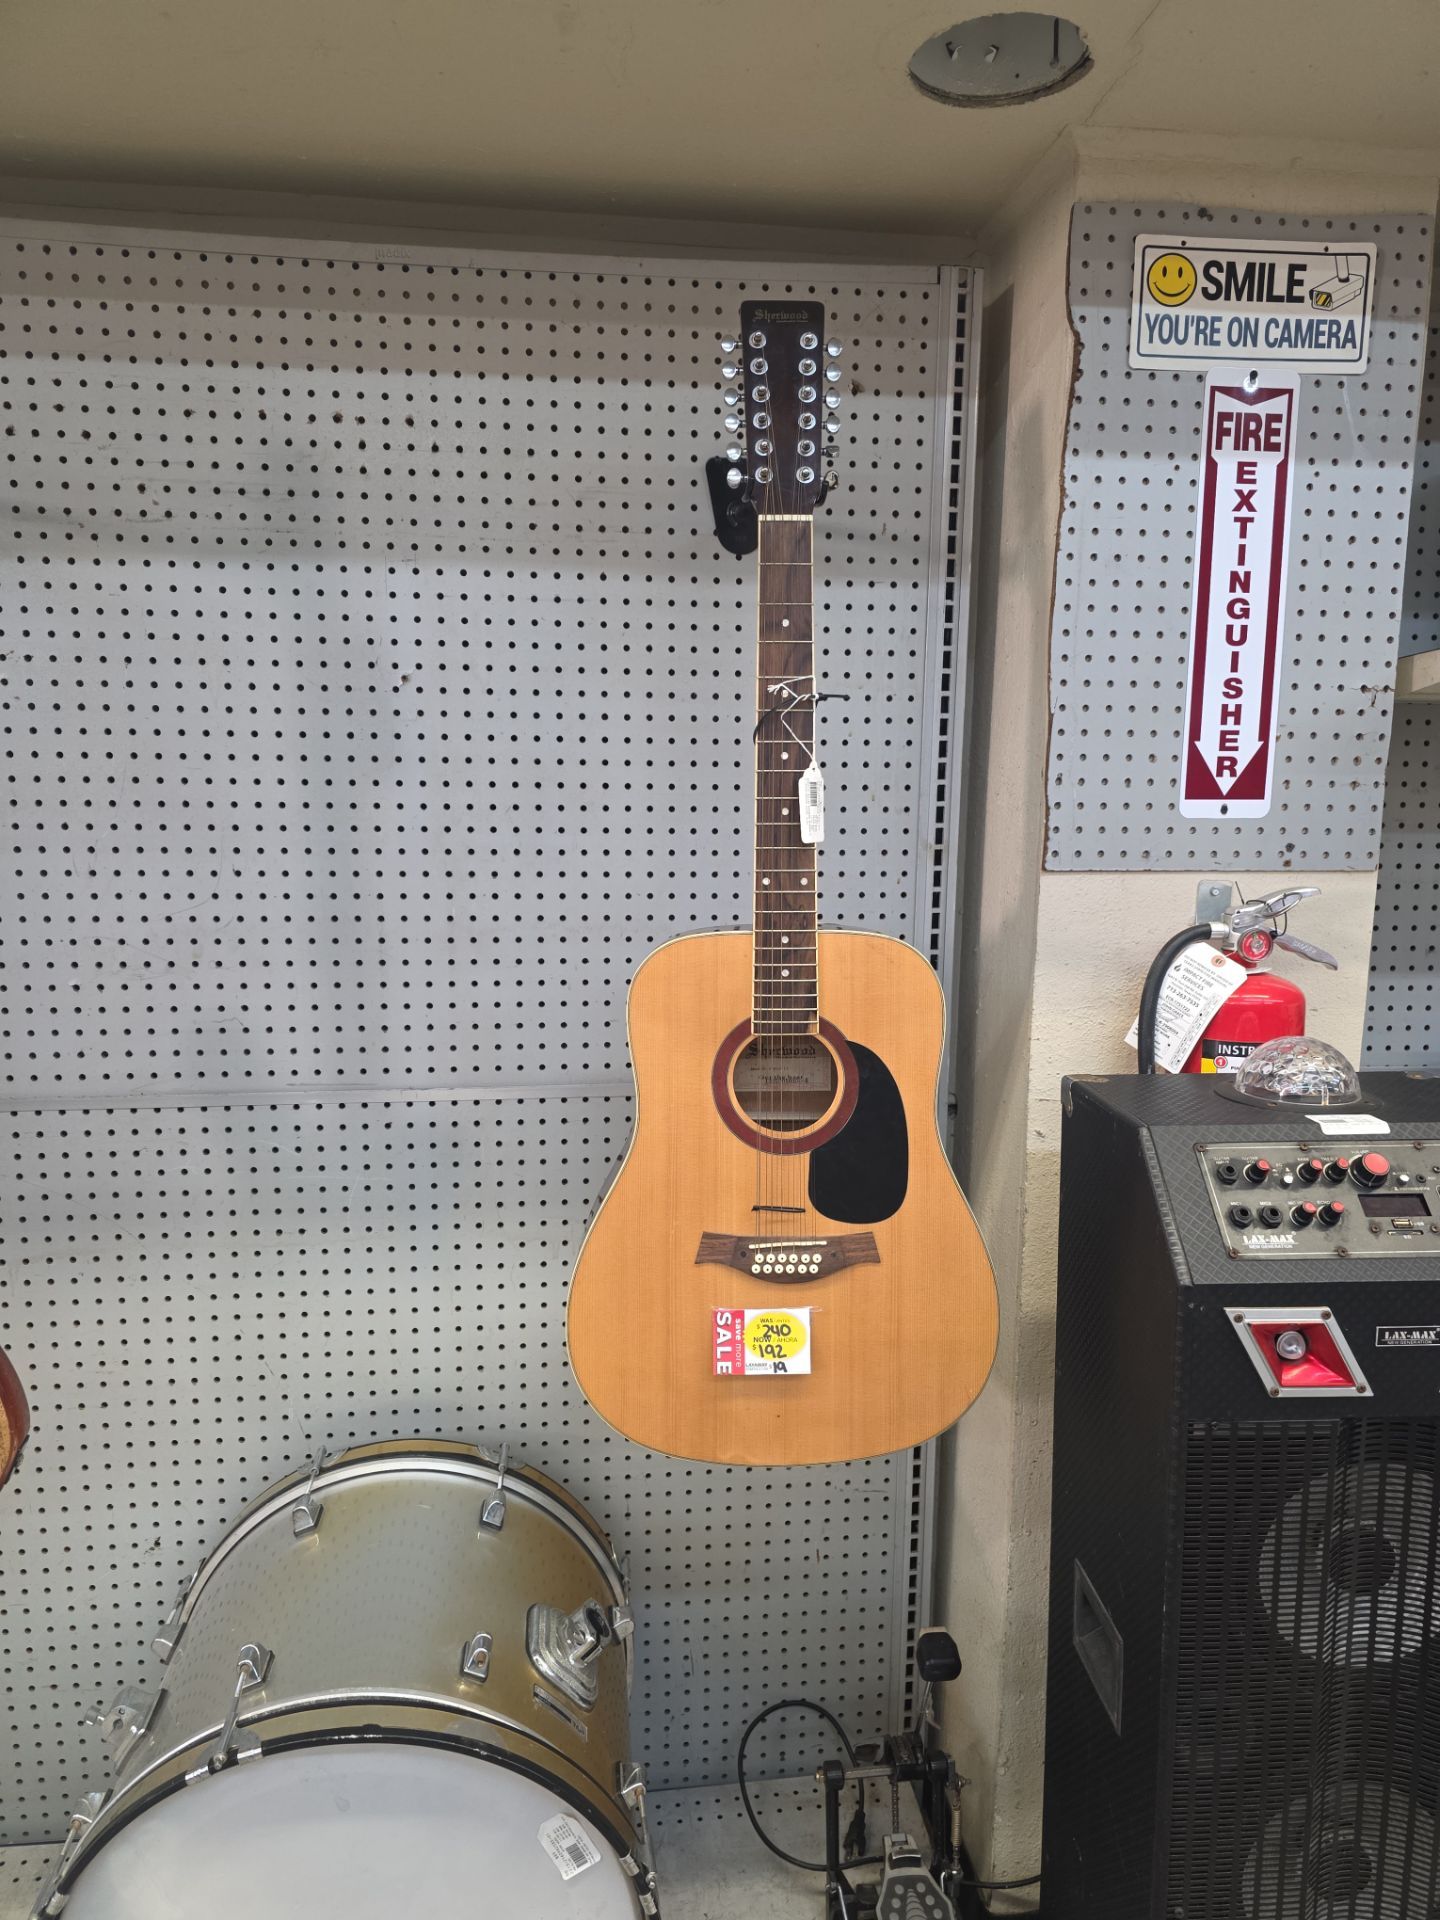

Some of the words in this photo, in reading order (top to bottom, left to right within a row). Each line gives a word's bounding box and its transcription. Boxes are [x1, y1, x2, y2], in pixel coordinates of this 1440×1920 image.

[1201, 260, 1307, 304] SMILE
[753, 308, 809, 323] Sherwood
[1145, 313, 1223, 347] YOU'RE
[1227, 316, 1260, 348] ON
[1264, 317, 1357, 350] CAMERA
[1215, 411, 1284, 453] FIRE
[1216, 461, 1258, 778] EXTINGUISHER
[1242, 1234, 1295, 1244] LAX-MAX
[716, 1311, 732, 1375] SALE
[1385, 1331, 1436, 1339] LAX-MAX
